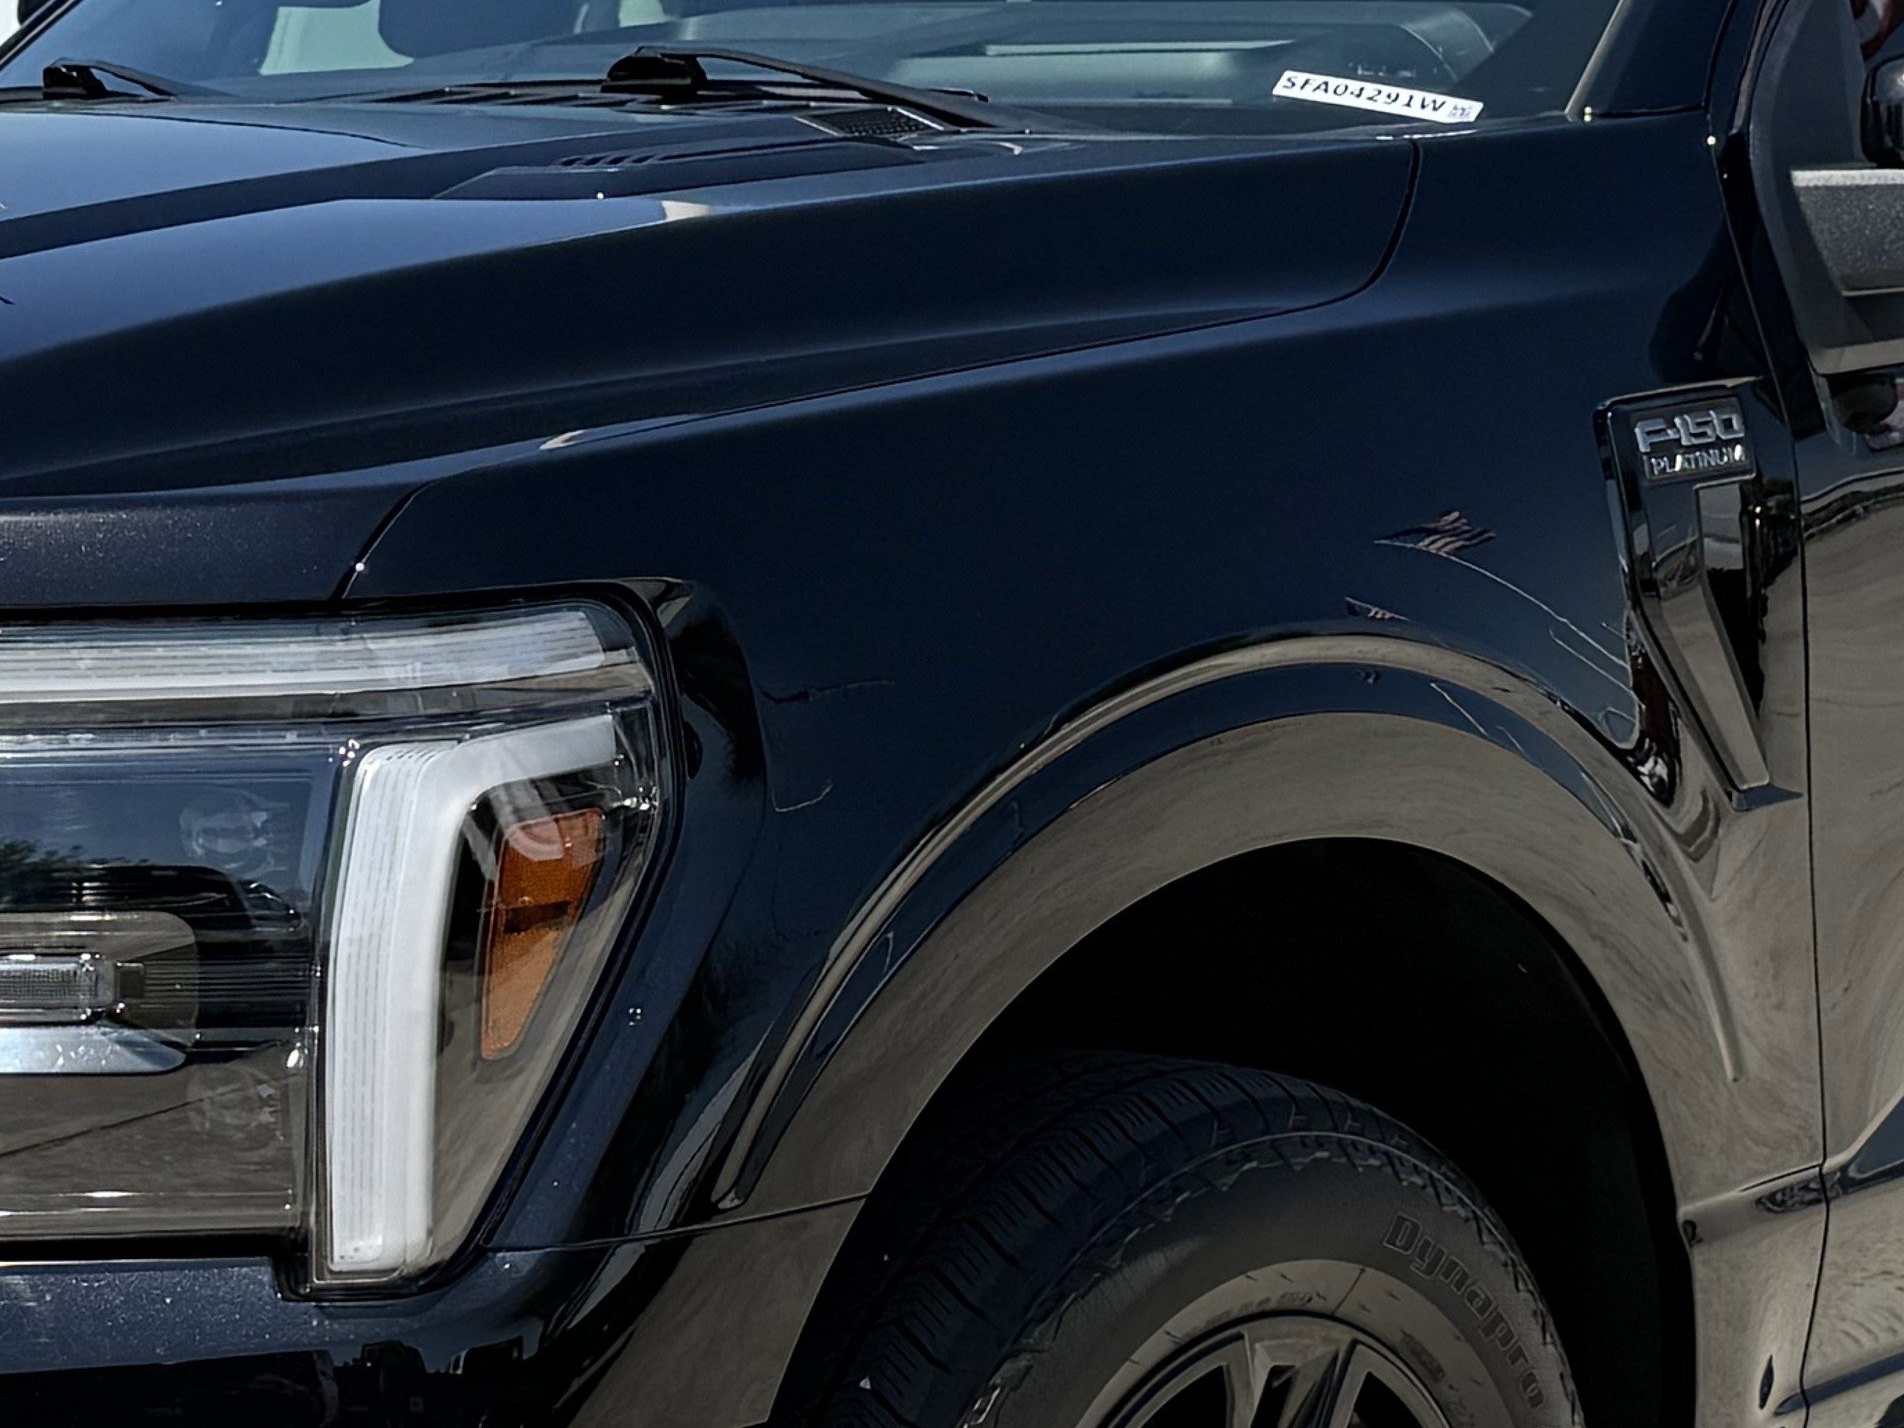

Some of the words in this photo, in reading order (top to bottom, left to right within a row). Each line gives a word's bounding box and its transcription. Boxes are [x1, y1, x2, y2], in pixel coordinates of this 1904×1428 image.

[1634, 409, 1746, 453] F-150
[1650, 443, 1747, 476] PLATINUM
[1382, 1210, 1545, 1410] Dynapro
